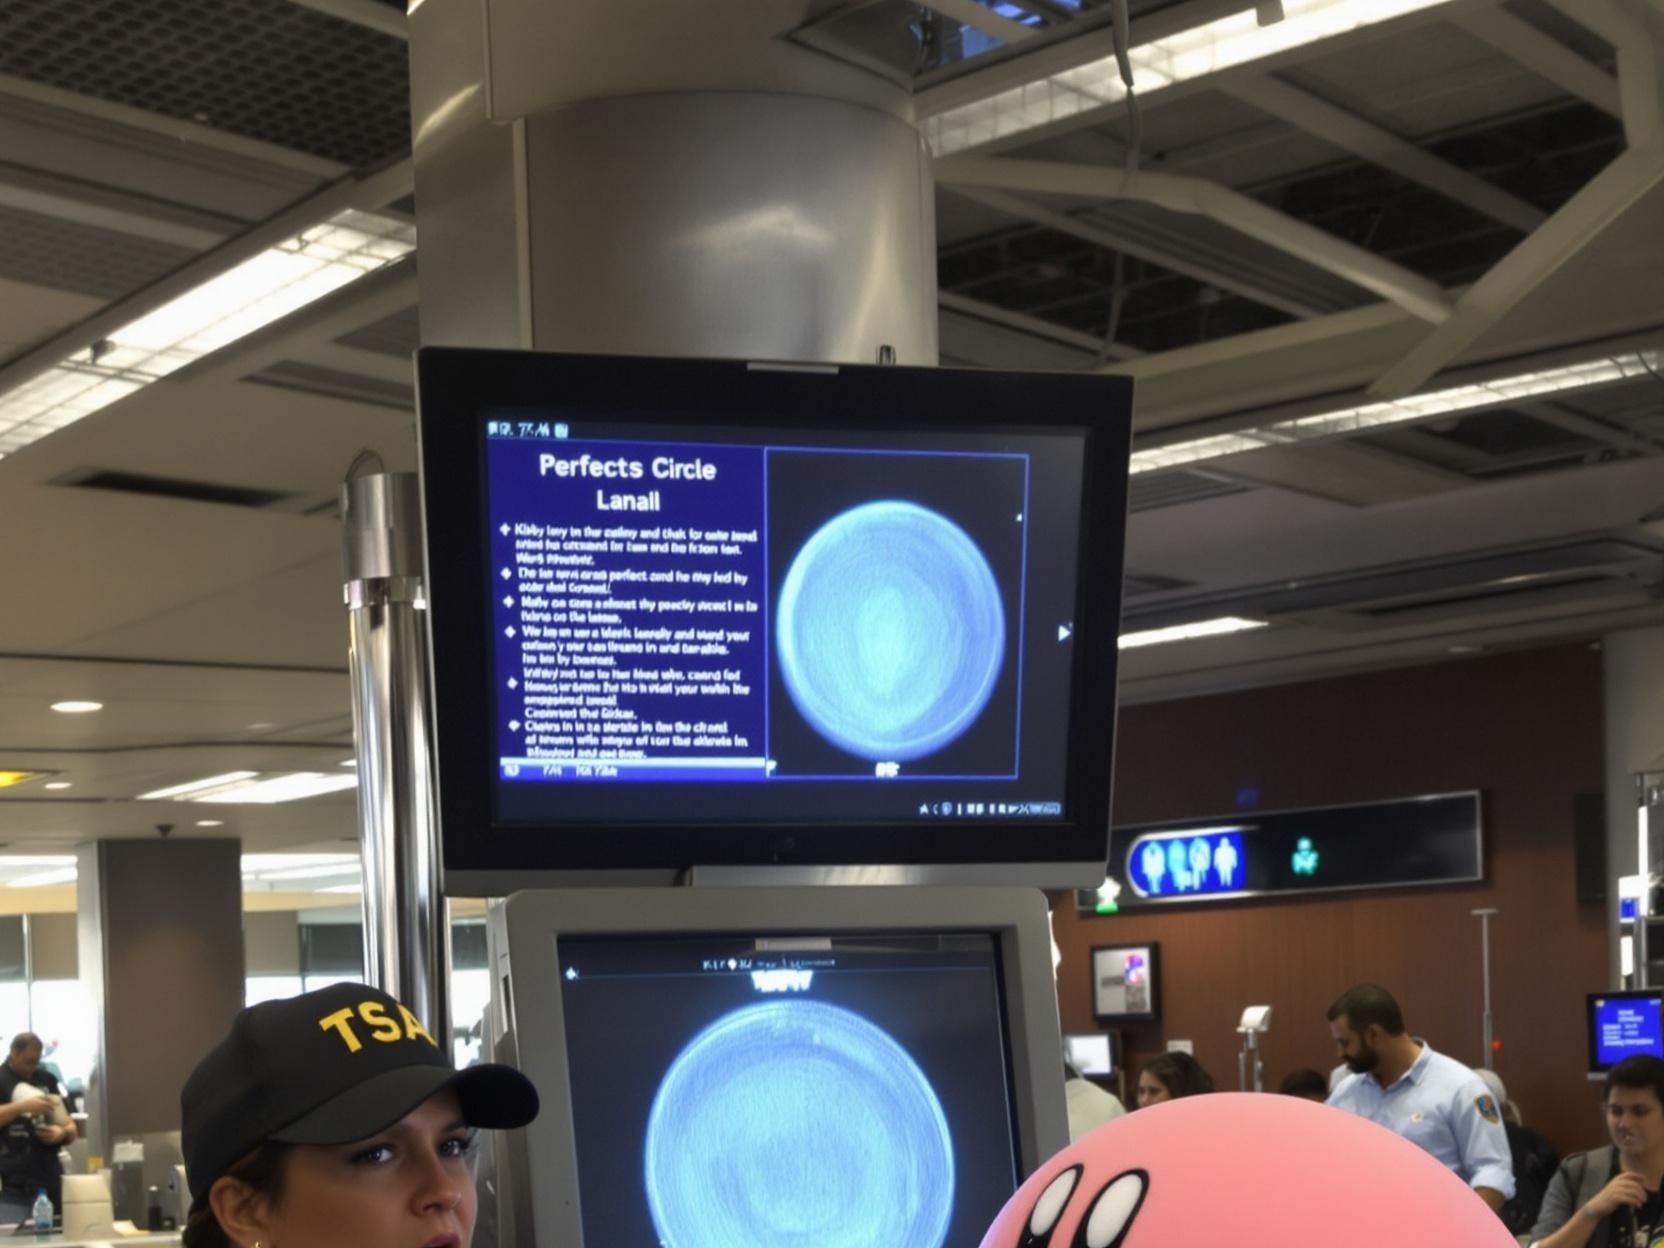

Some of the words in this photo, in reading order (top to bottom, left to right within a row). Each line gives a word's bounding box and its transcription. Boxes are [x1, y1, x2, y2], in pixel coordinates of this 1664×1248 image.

[539, 453, 643, 478] Perfects
[652, 457, 717, 480] Circle
[319, 1001, 438, 1053] TSA
